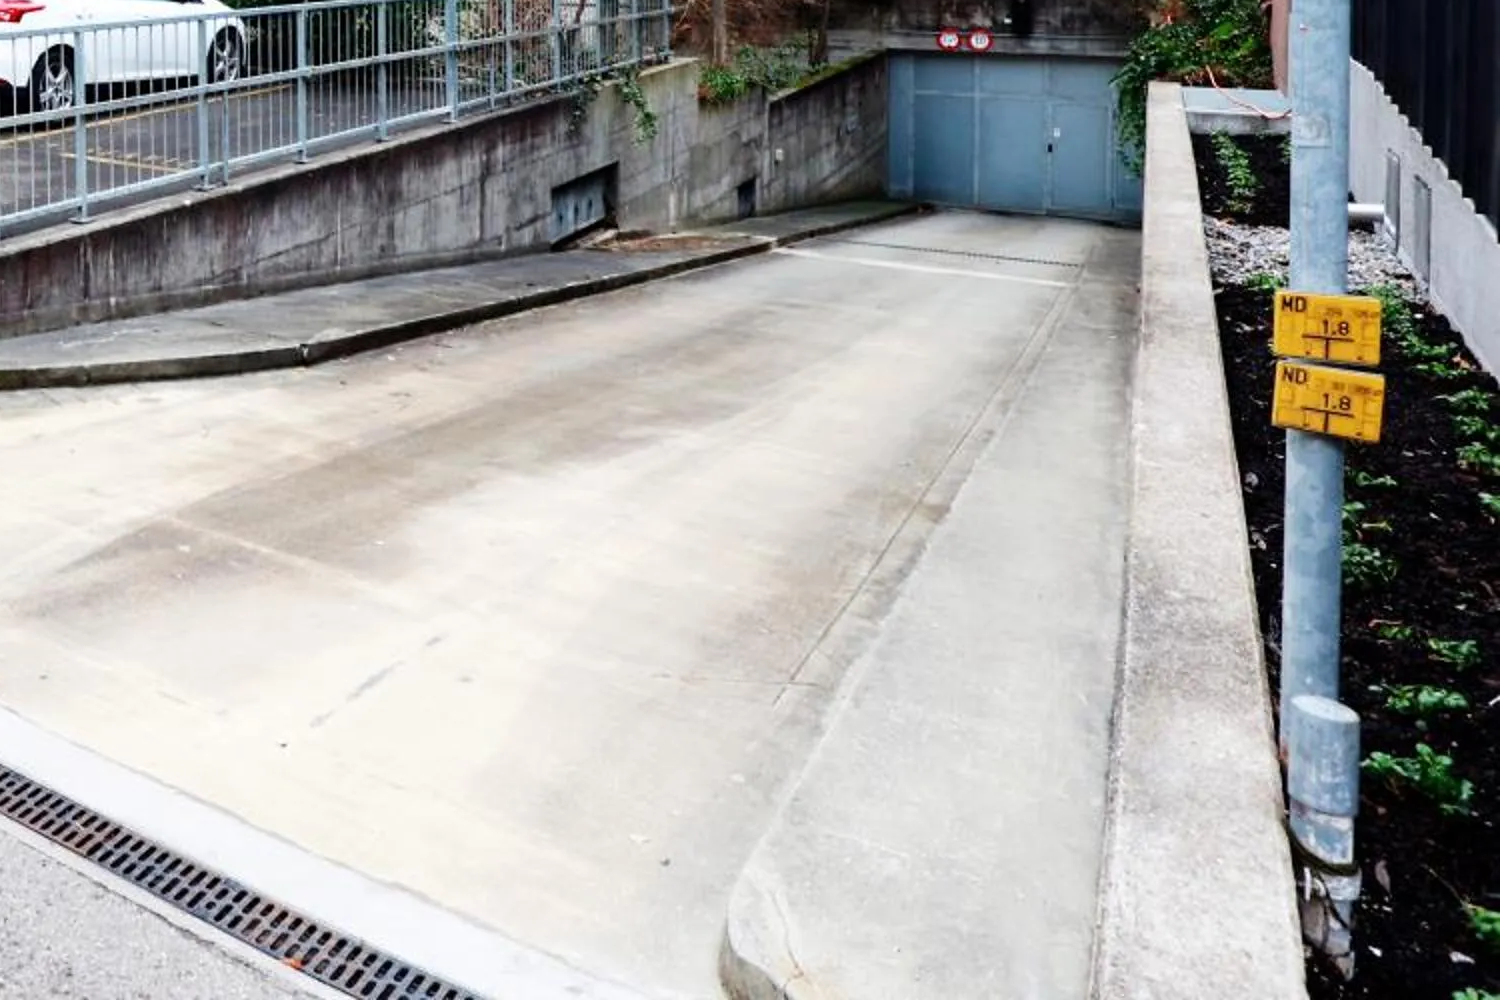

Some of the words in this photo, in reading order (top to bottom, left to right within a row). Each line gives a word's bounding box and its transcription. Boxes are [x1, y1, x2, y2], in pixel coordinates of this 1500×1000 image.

[1322, 319, 1349, 336] 1.8
[1282, 367, 1307, 384] ND
[1322, 392, 1351, 410] 1.8
